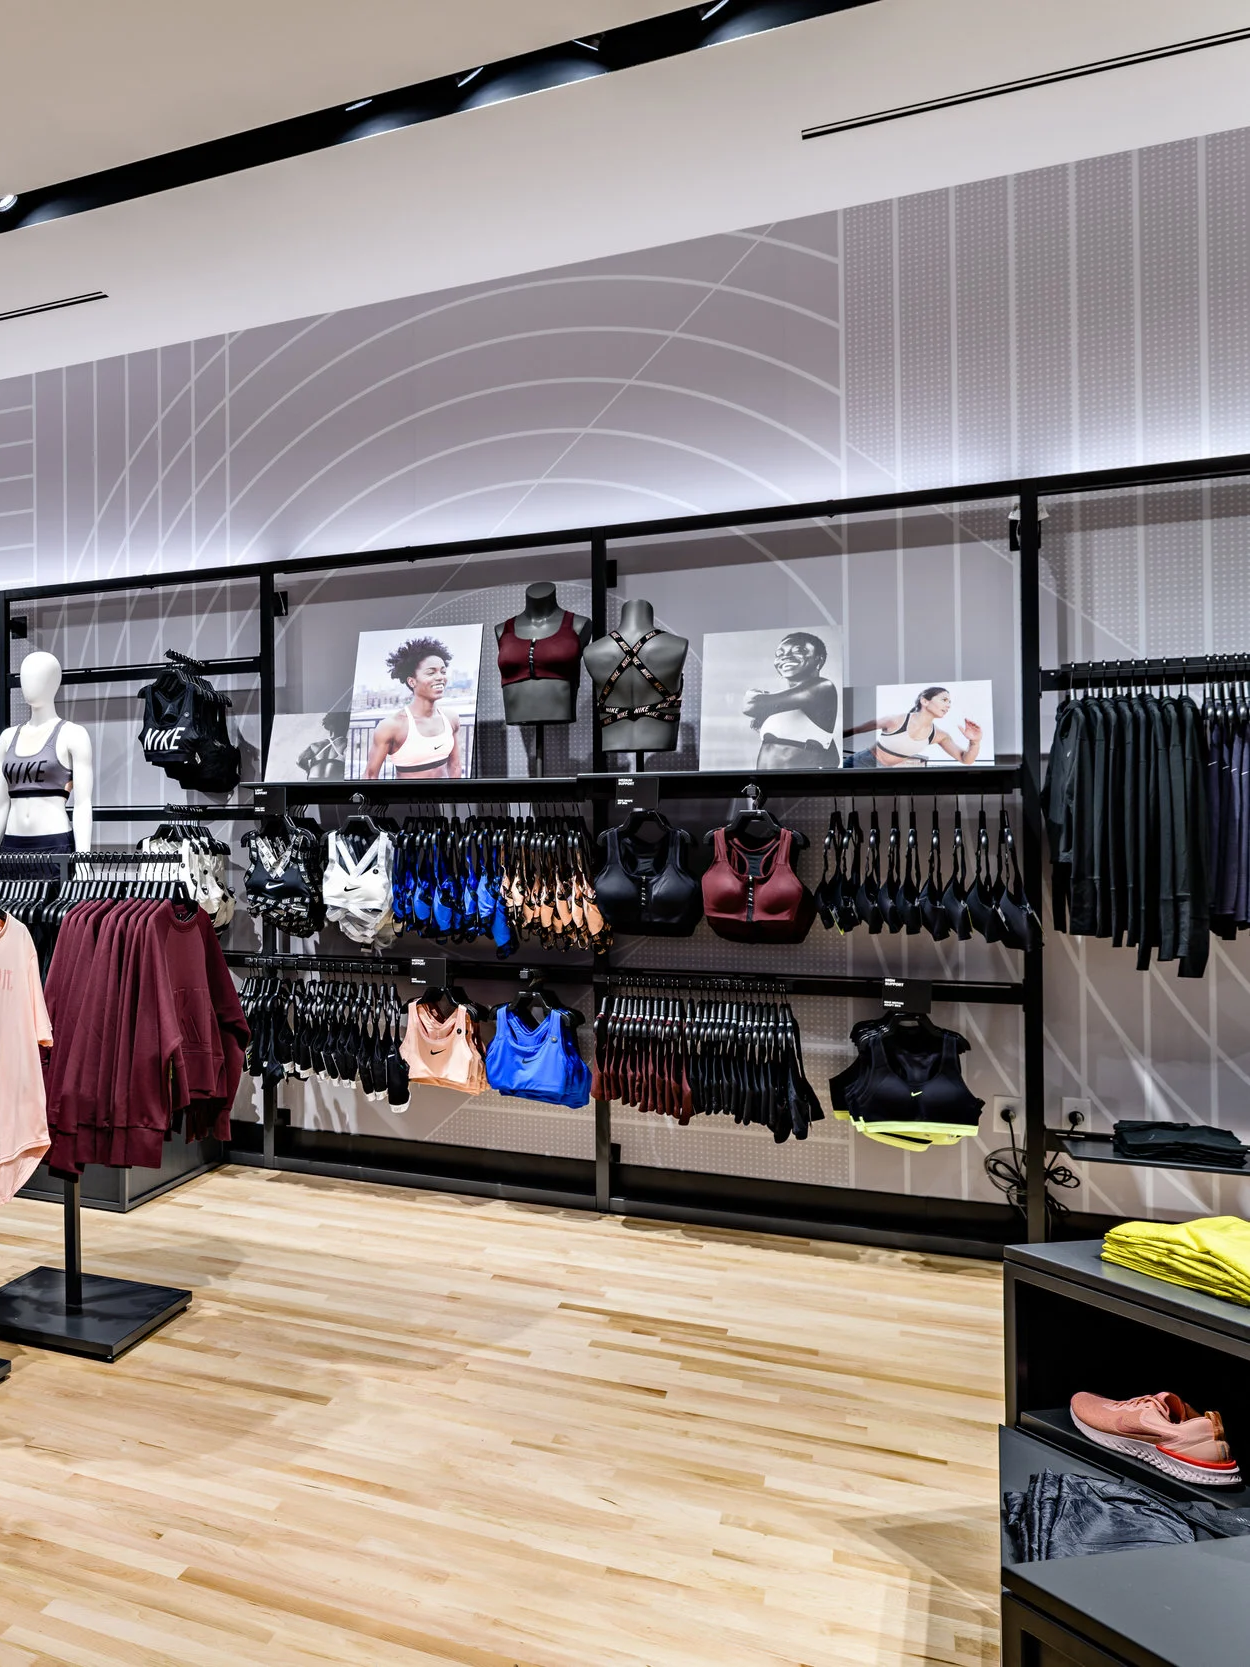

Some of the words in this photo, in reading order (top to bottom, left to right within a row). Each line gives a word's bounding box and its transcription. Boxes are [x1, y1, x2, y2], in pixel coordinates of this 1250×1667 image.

[634, 706, 650, 714] NIKE
[143, 727, 186, 751] NIKE
[3, 760, 48, 784] NIKE
[2, 969, 13, 991] IT.
